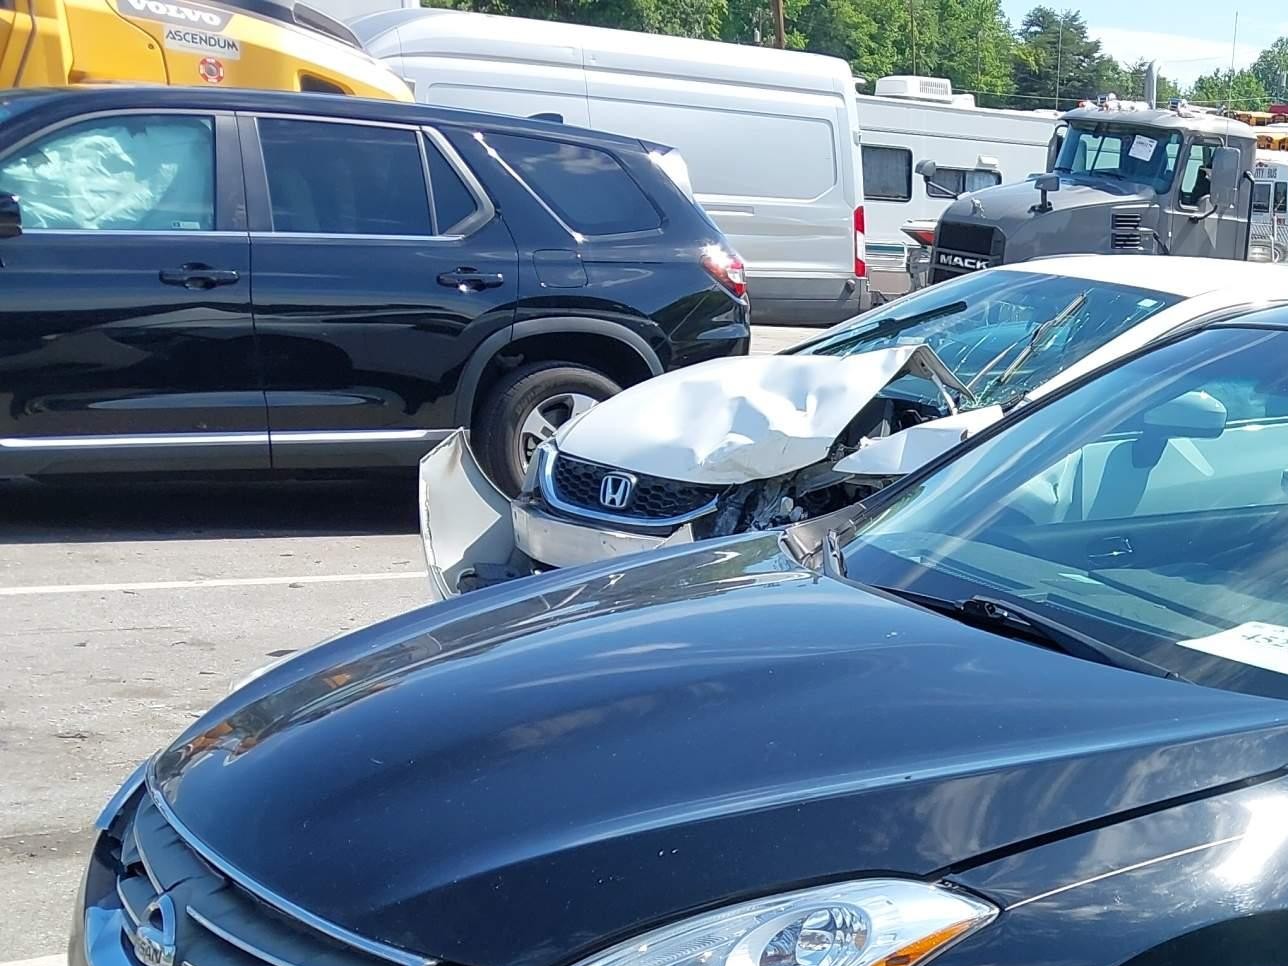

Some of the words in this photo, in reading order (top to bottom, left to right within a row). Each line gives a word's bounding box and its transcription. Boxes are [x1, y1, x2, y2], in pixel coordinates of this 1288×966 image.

[127, 0, 222, 26] VOLVO
[166, 29, 239, 52] ASCENDUM
[940, 254, 990, 270] MACK
